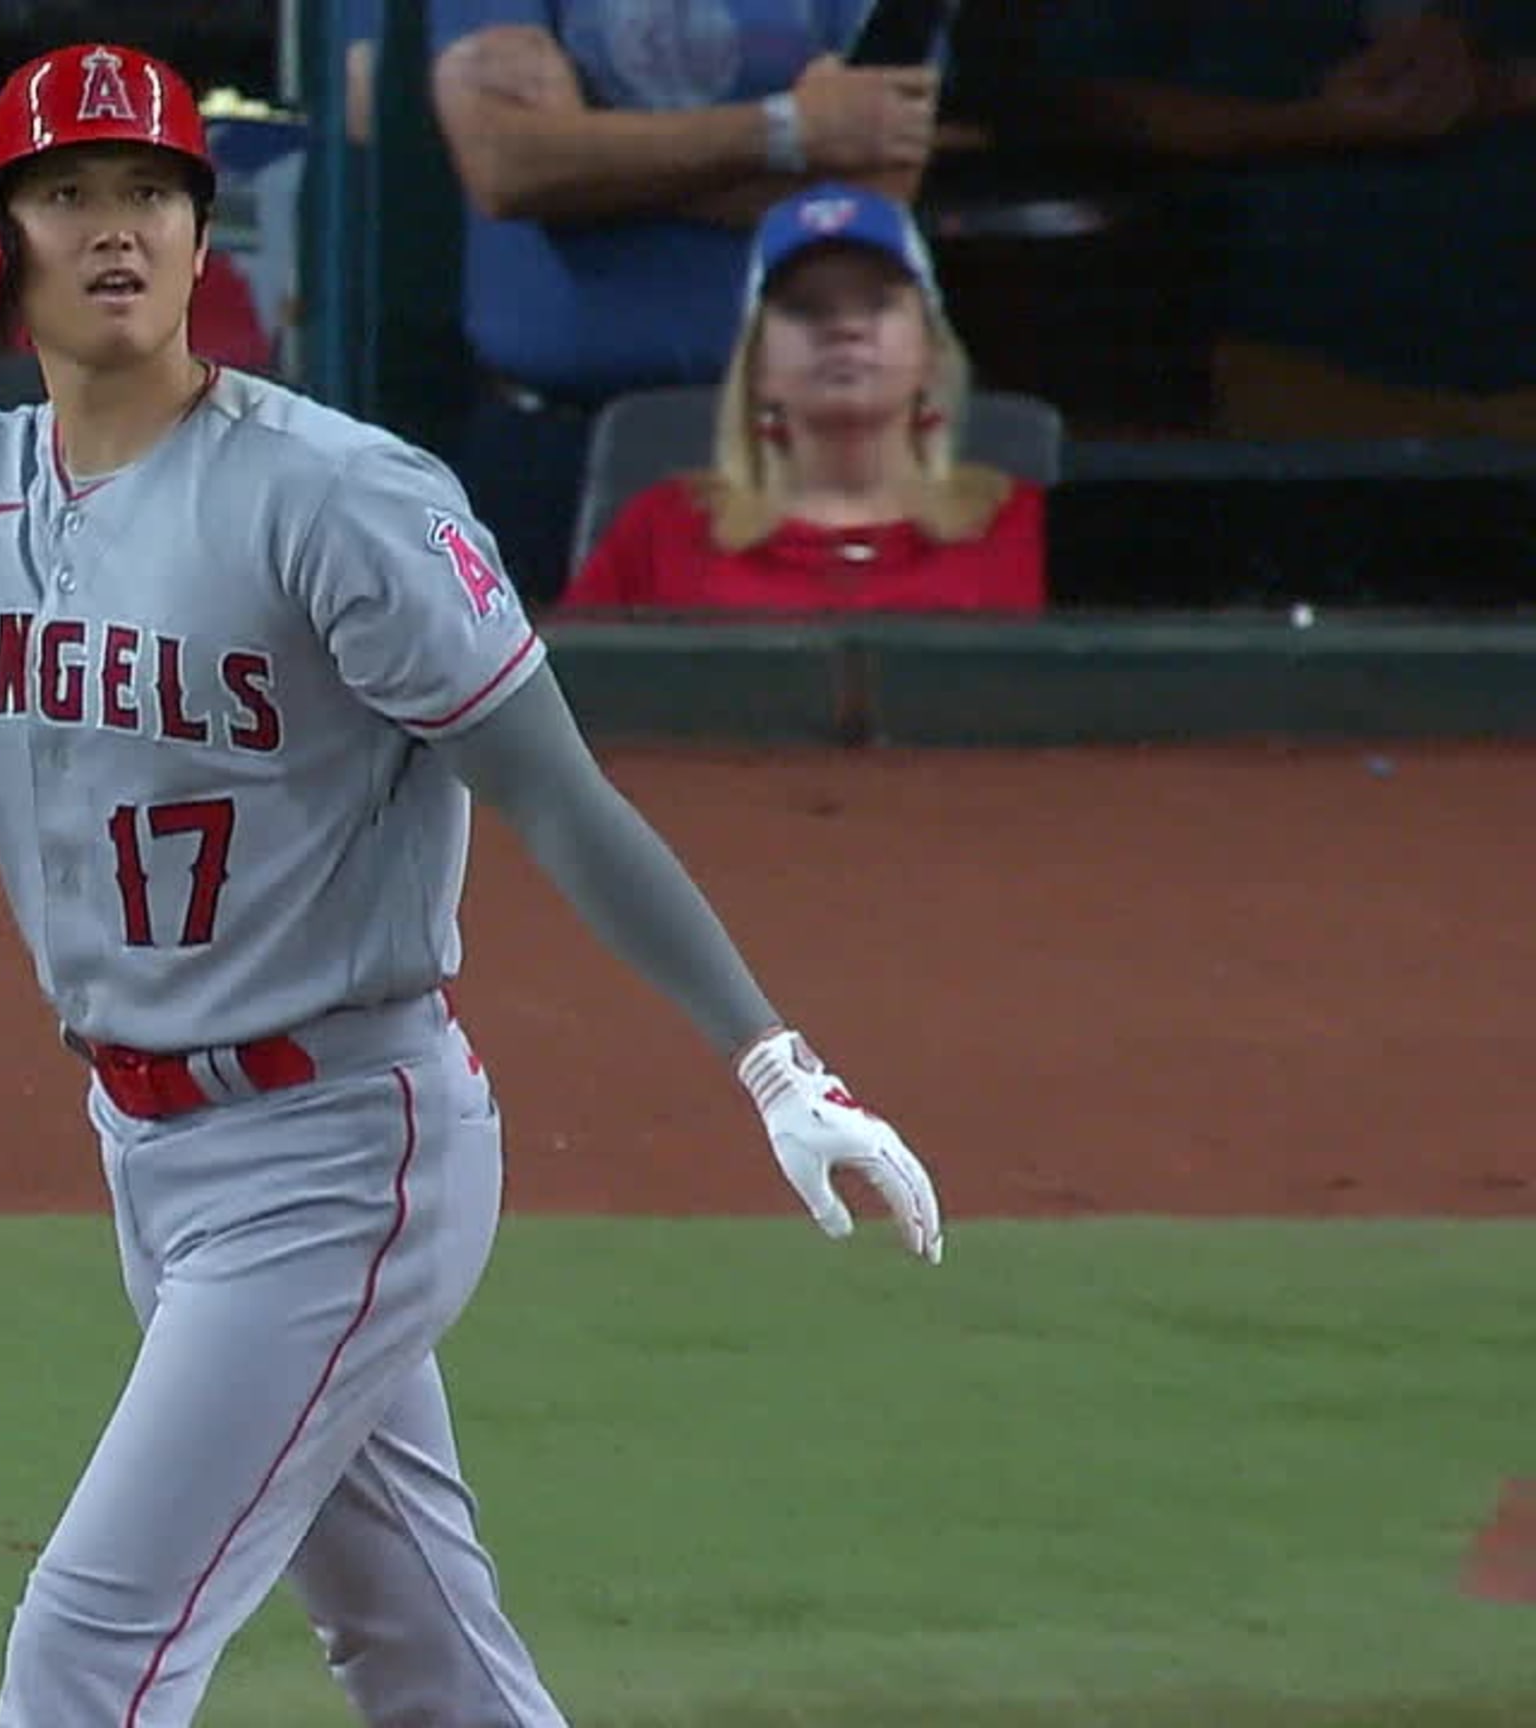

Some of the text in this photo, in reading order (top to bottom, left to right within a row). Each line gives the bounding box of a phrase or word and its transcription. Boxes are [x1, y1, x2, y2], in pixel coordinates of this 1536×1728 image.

[76, 48, 136, 120] A
[428, 510, 510, 625] A
[107, 795, 237, 955] 17
